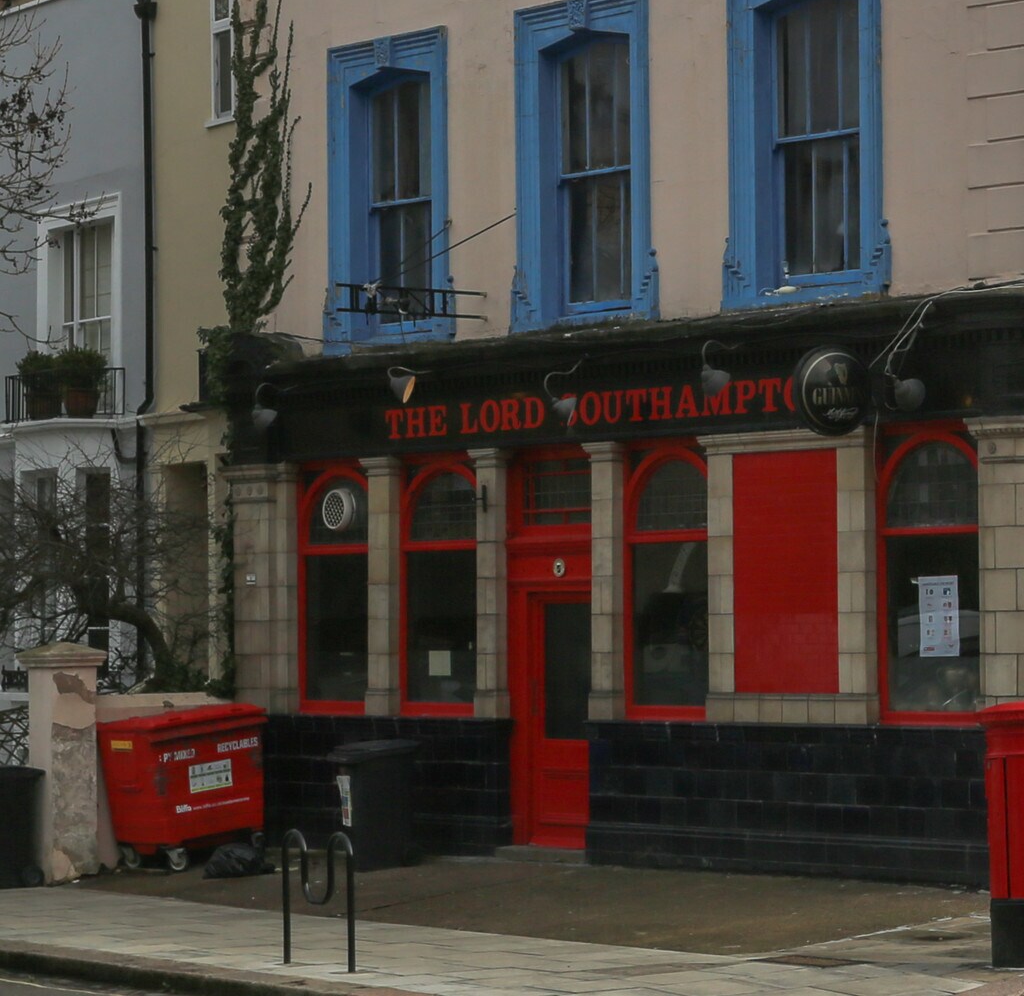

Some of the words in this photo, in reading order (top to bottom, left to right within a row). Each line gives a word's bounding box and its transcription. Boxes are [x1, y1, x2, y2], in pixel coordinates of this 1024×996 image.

[812, 387, 865, 405] GUINN
[385, 405, 448, 439] THE
[460, 397, 545, 435] LORD
[560, 375, 797, 427] OUTHAMPT
[216, 737, 260, 753] RECYCLABLES
[175, 803, 192, 814] Biffa
